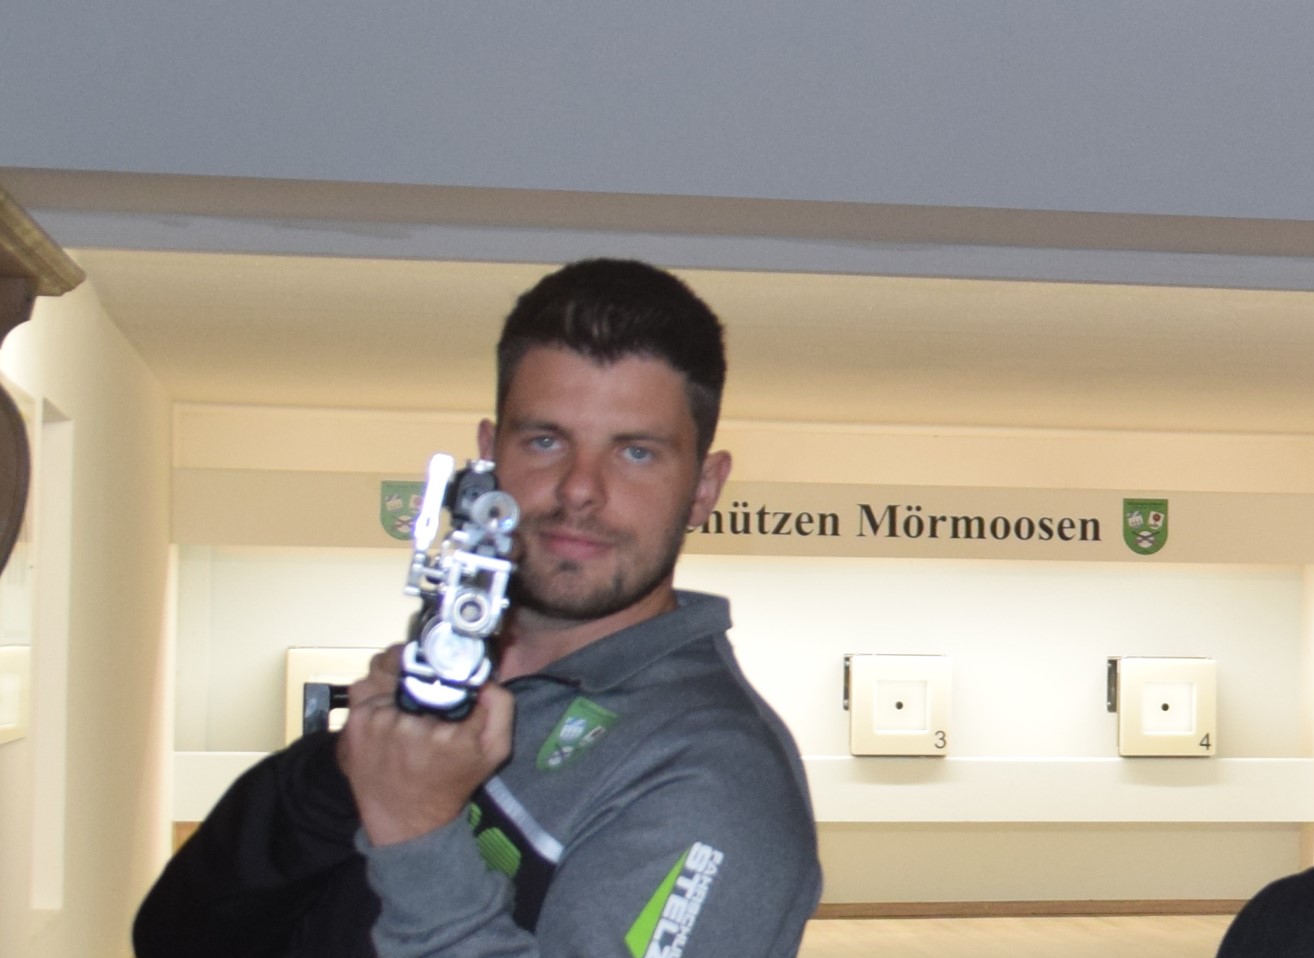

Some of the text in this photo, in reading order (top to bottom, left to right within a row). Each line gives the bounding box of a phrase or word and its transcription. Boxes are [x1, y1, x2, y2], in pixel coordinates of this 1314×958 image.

[685, 501, 1102, 541] hützen Mörmoosen
[935, 730, 946, 749] 3
[1199, 732, 1211, 750] 4
